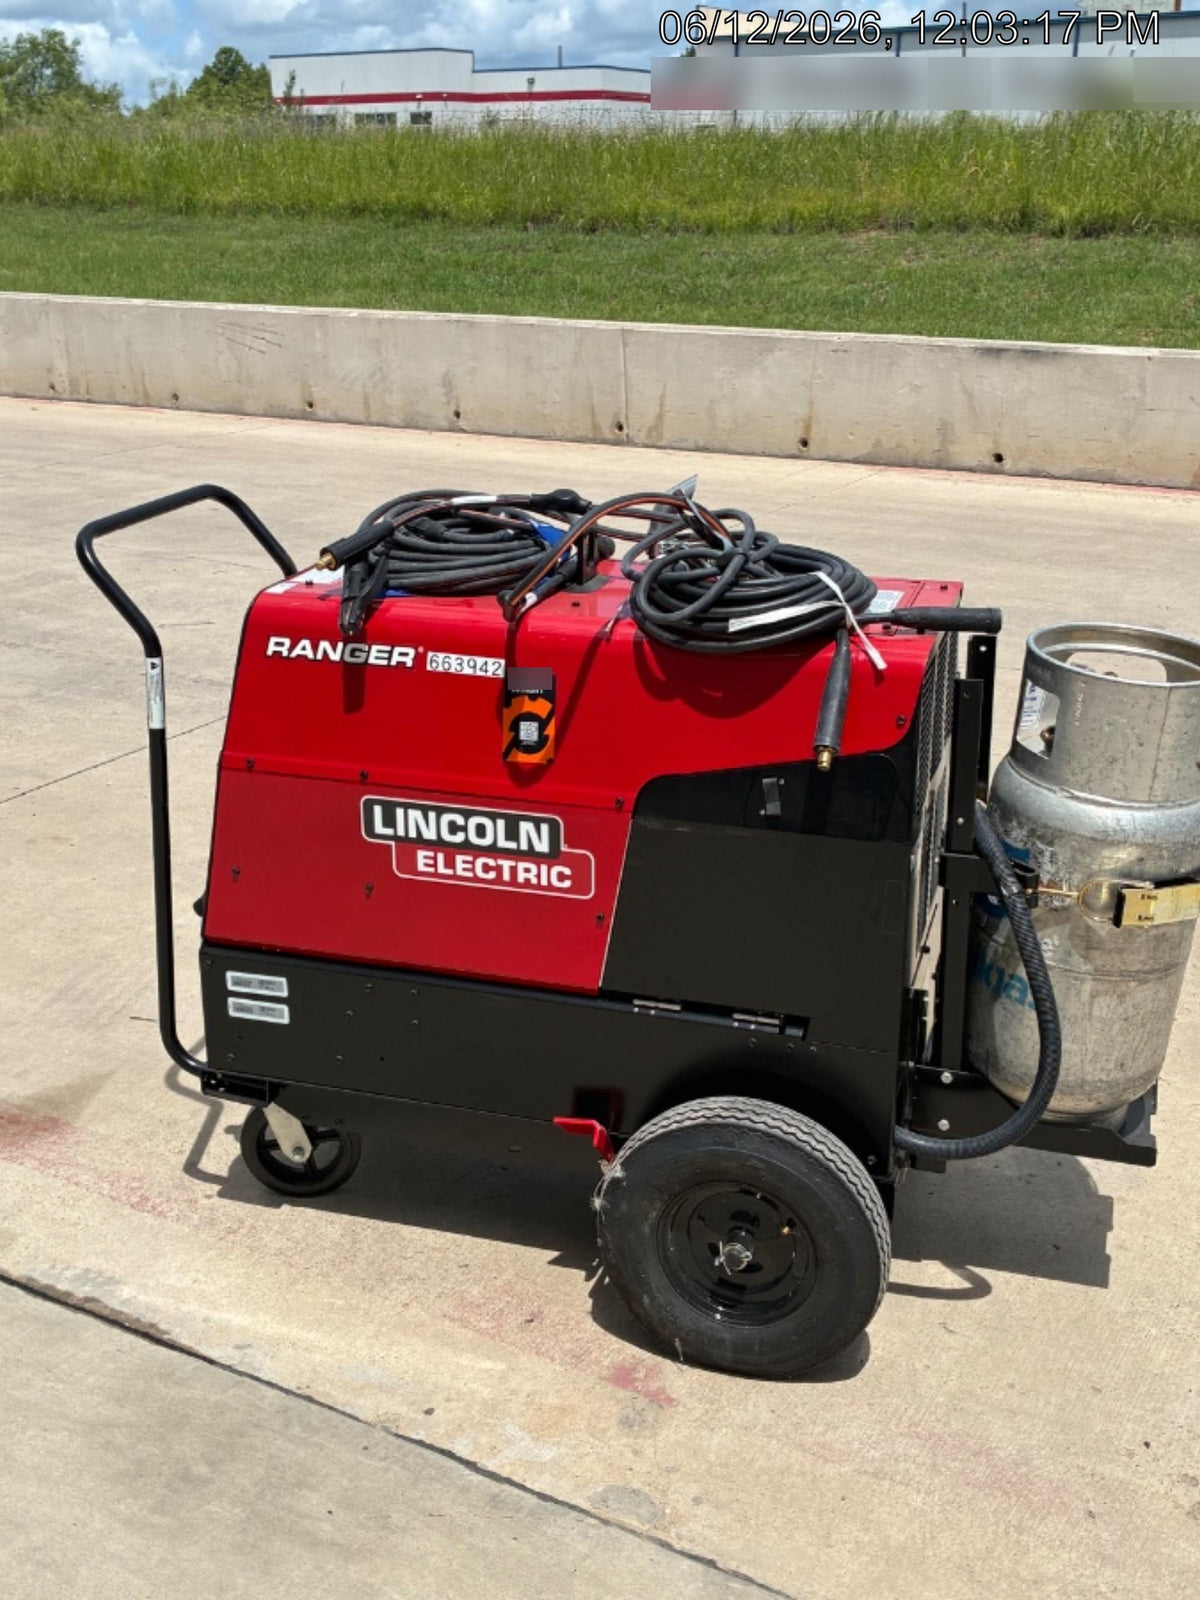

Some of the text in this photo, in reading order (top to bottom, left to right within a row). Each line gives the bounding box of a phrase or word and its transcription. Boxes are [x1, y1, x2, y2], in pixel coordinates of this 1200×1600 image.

[266, 635, 416, 668] RANGER
[429, 653, 503, 677] 663942
[372, 804, 551, 854] LINCOLN
[416, 849, 573, 889] ELECTRIC
